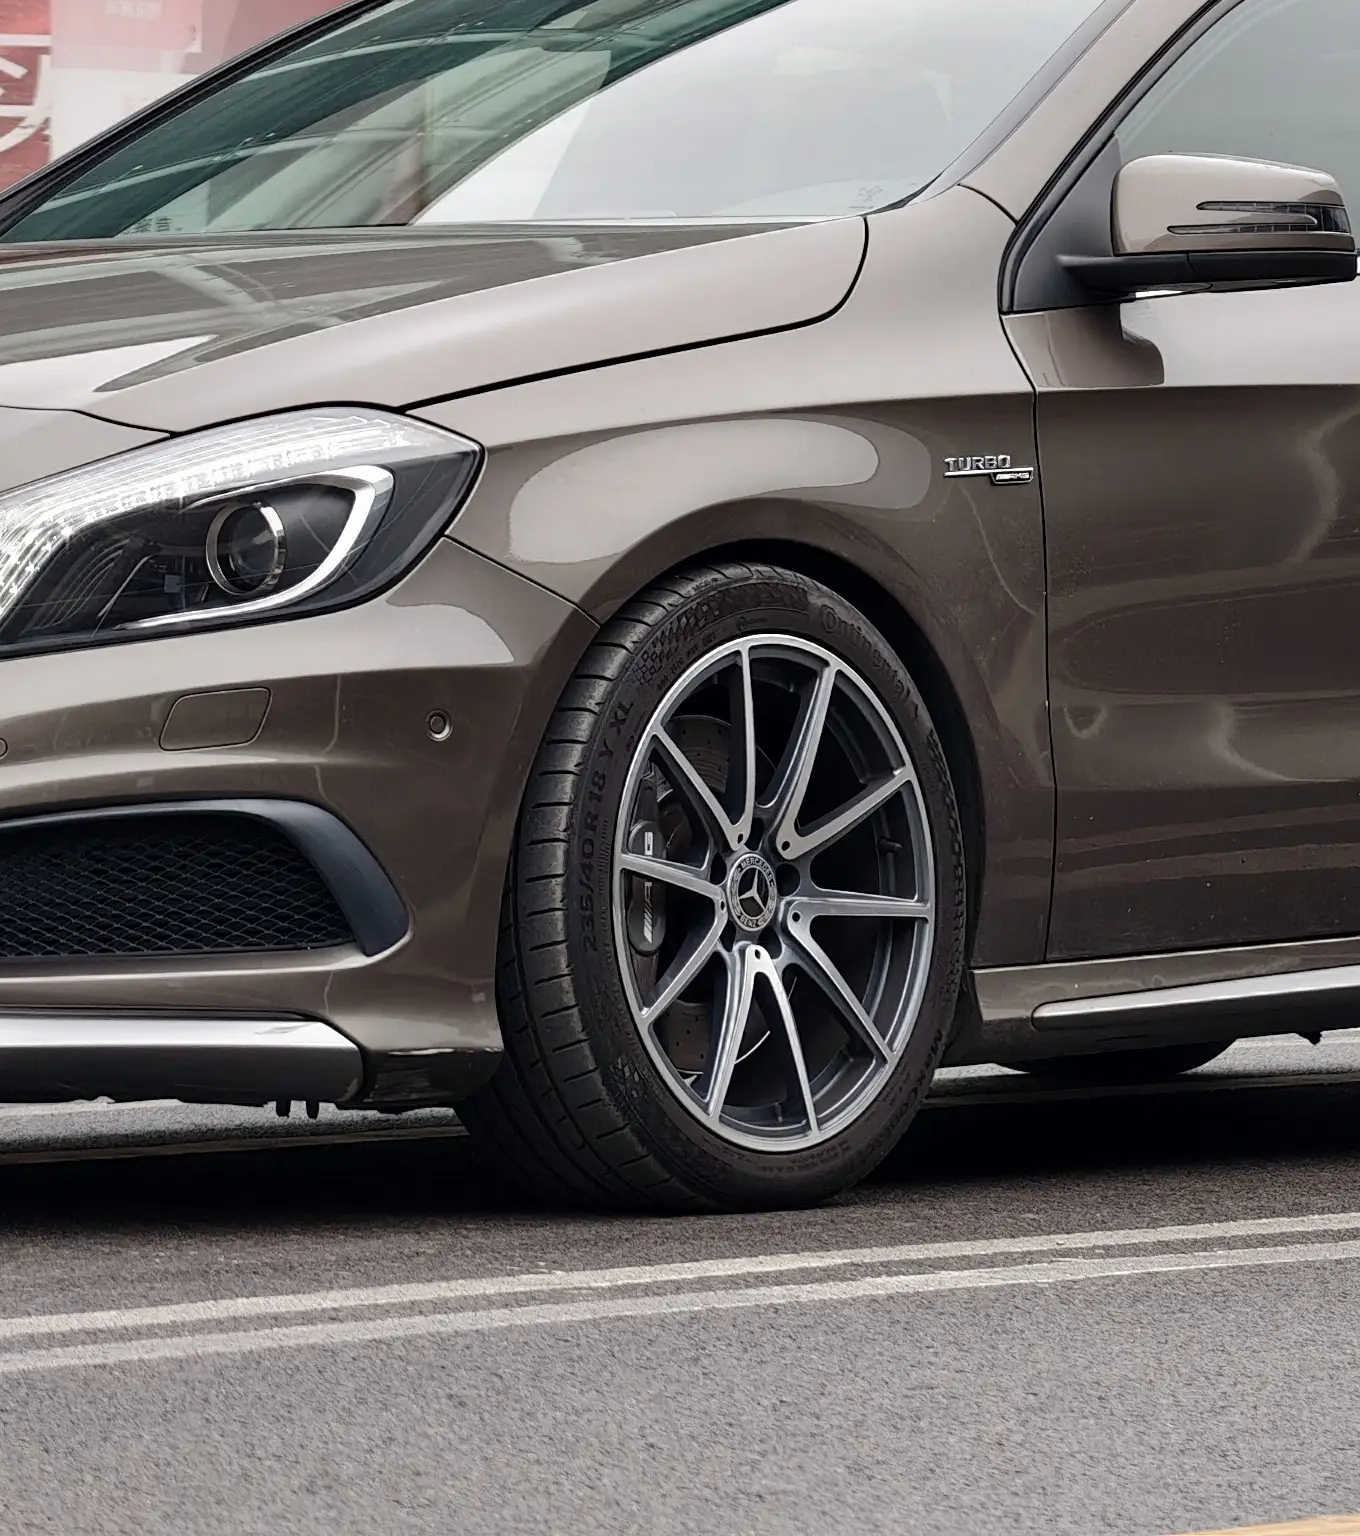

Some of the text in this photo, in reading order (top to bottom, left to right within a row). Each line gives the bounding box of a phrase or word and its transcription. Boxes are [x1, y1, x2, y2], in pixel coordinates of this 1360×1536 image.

[944, 455, 1011, 472] TURBO
[741, 857, 772, 881] MERCEDES
[740, 914, 757, 928] BENZ
